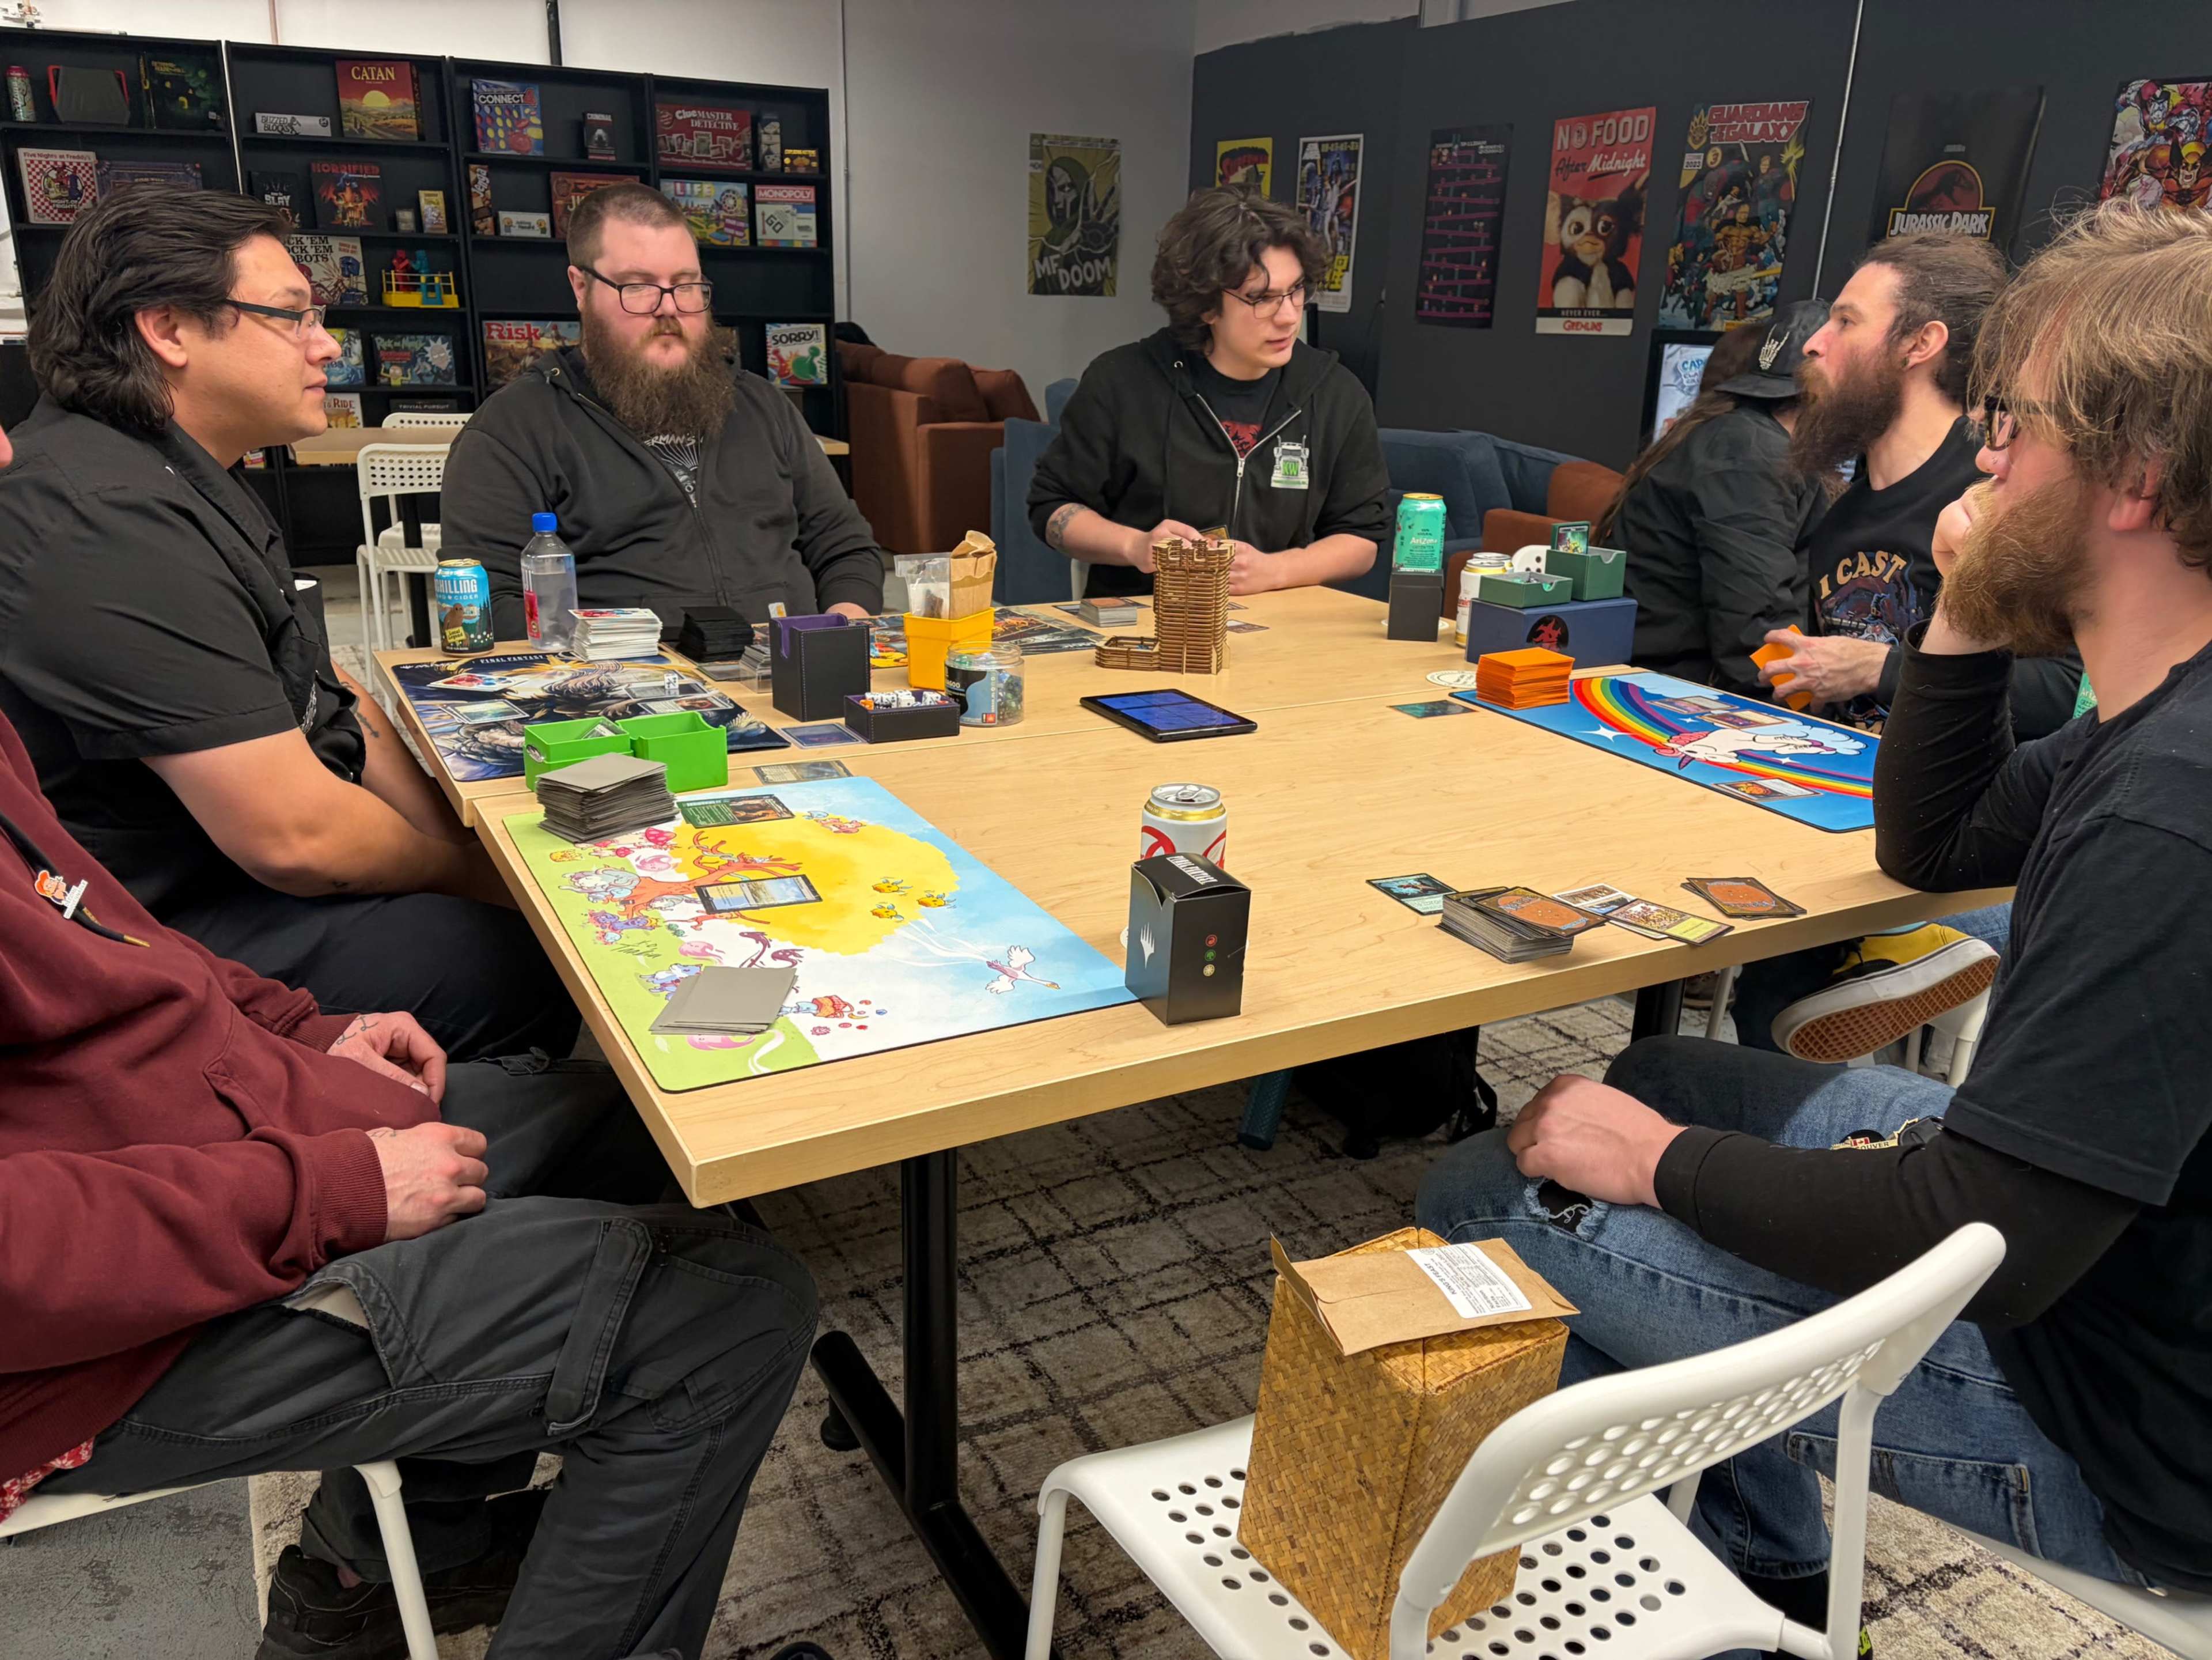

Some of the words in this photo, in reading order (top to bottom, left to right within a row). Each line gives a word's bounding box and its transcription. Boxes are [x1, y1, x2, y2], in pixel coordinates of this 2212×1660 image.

[351, 66, 395, 80] CATAN
[478, 94, 525, 104] CONNECT
[261, 115, 288, 124] BUZZED
[675, 109, 697, 120] Clue
[696, 111, 732, 120] MASTER
[1709, 101, 1808, 124] GUARDIANS
[691, 119, 739, 130] DETECTIVE
[1591, 115, 1650, 148] FOOD
[1724, 122, 1801, 142] GALAXY
[1587, 149, 1646, 177] Midnight
[1709, 152, 1719, 166] 3
[311, 162, 380, 175] HORRIFIED
[471, 168, 490, 197] Jenga
[676, 182, 713, 196] LIFE
[264, 194, 290, 206] SLAY
[758, 188, 811, 199] MONOPOLY
[766, 214, 784, 233] GO
[1890, 211, 1949, 236] JURASSIC
[1951, 211, 1989, 235] PARK
[1035, 254, 1060, 279] MF
[1058, 256, 1112, 290] DOOM
[484, 322, 540, 340] Risk
[772, 330, 819, 345] SORRY!
[333, 398, 355, 409] RIDE
[1410, 536, 1438, 544] AriZona
[1819, 574, 1832, 600] I
[1836, 550, 1907, 585] CAST
[1424, 1262, 1441, 1279] FEAST
[1439, 1277, 1457, 1295] KING'S
